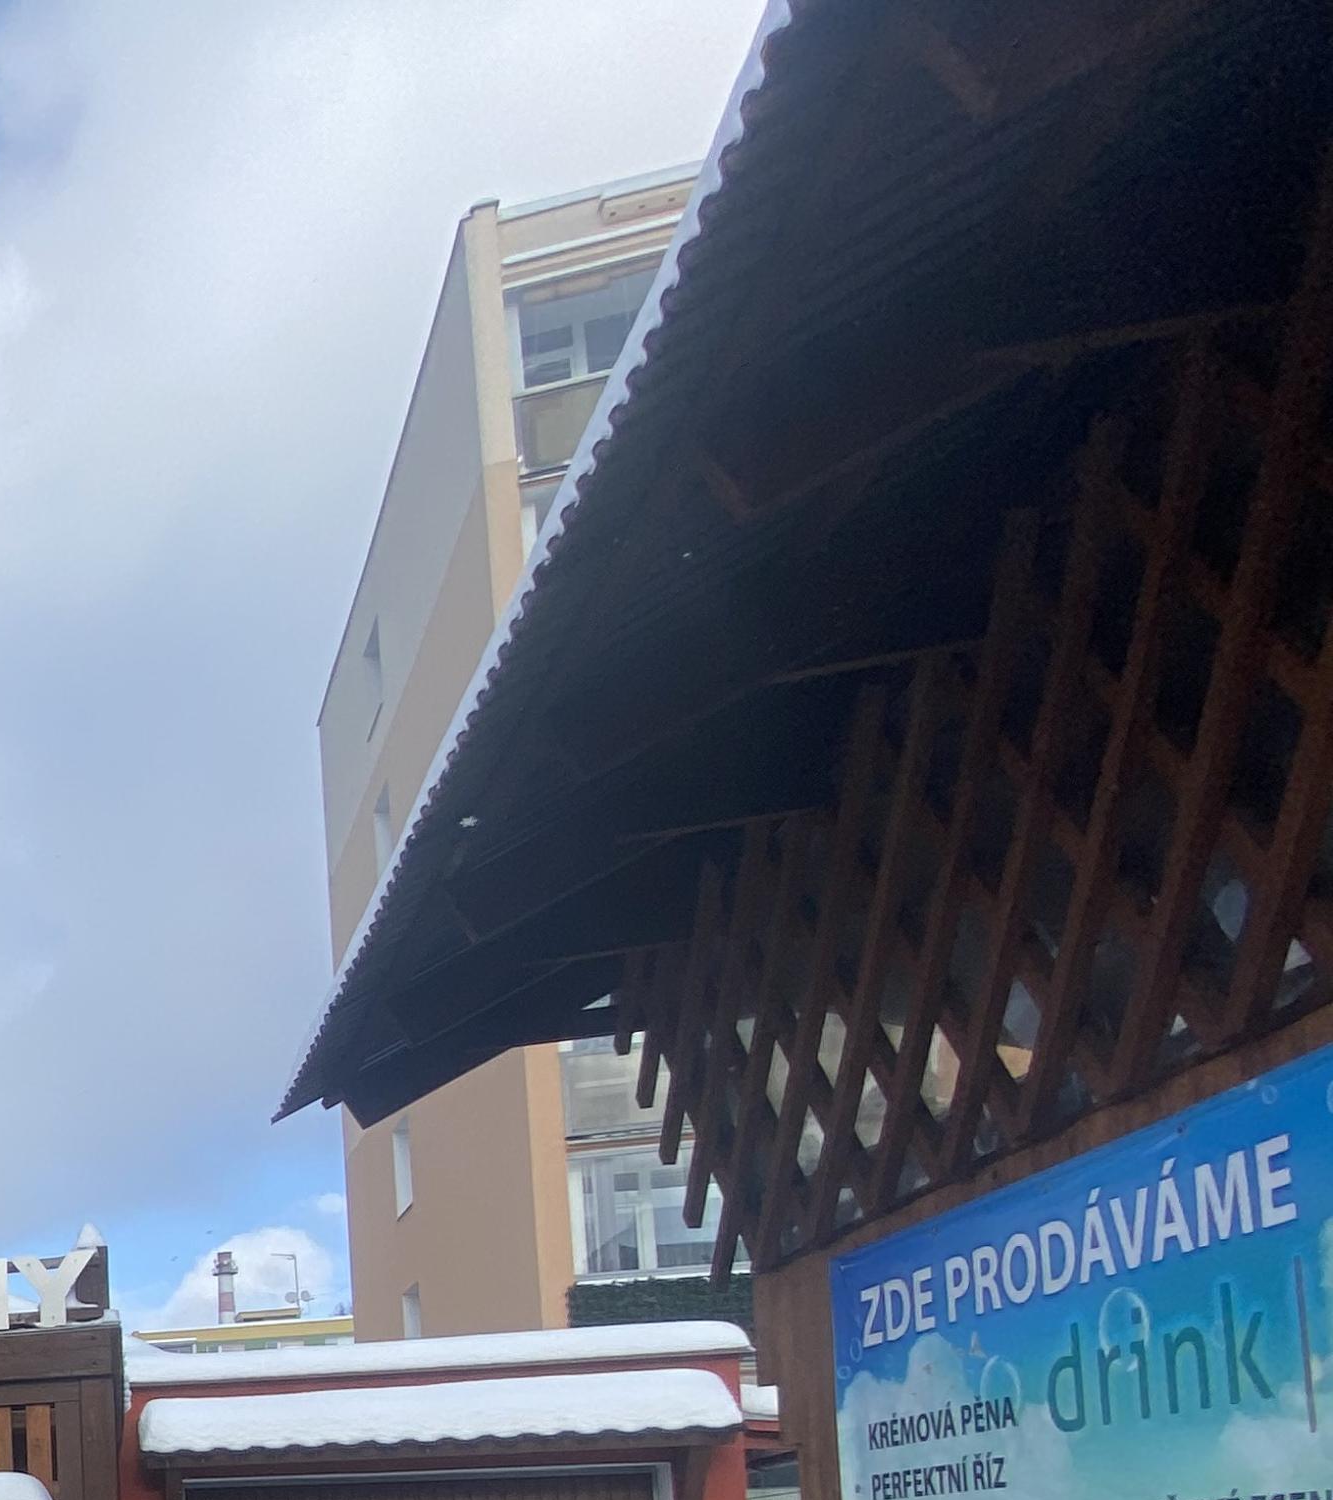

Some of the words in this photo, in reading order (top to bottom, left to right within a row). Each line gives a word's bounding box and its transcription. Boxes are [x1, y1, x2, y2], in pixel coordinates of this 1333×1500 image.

[859, 1266, 936, 1348] ZDE
[944, 1133, 1298, 1325] PRODÁVÁME
[1046, 1282, 1275, 1433] drink
[868, 1401, 957, 1450] KRÉMOVÁ
[961, 1395, 1018, 1436] PĚNA
[872, 1455, 968, 1500] PERFEKTNÍ
[973, 1451, 1007, 1491] ŘÍZ
